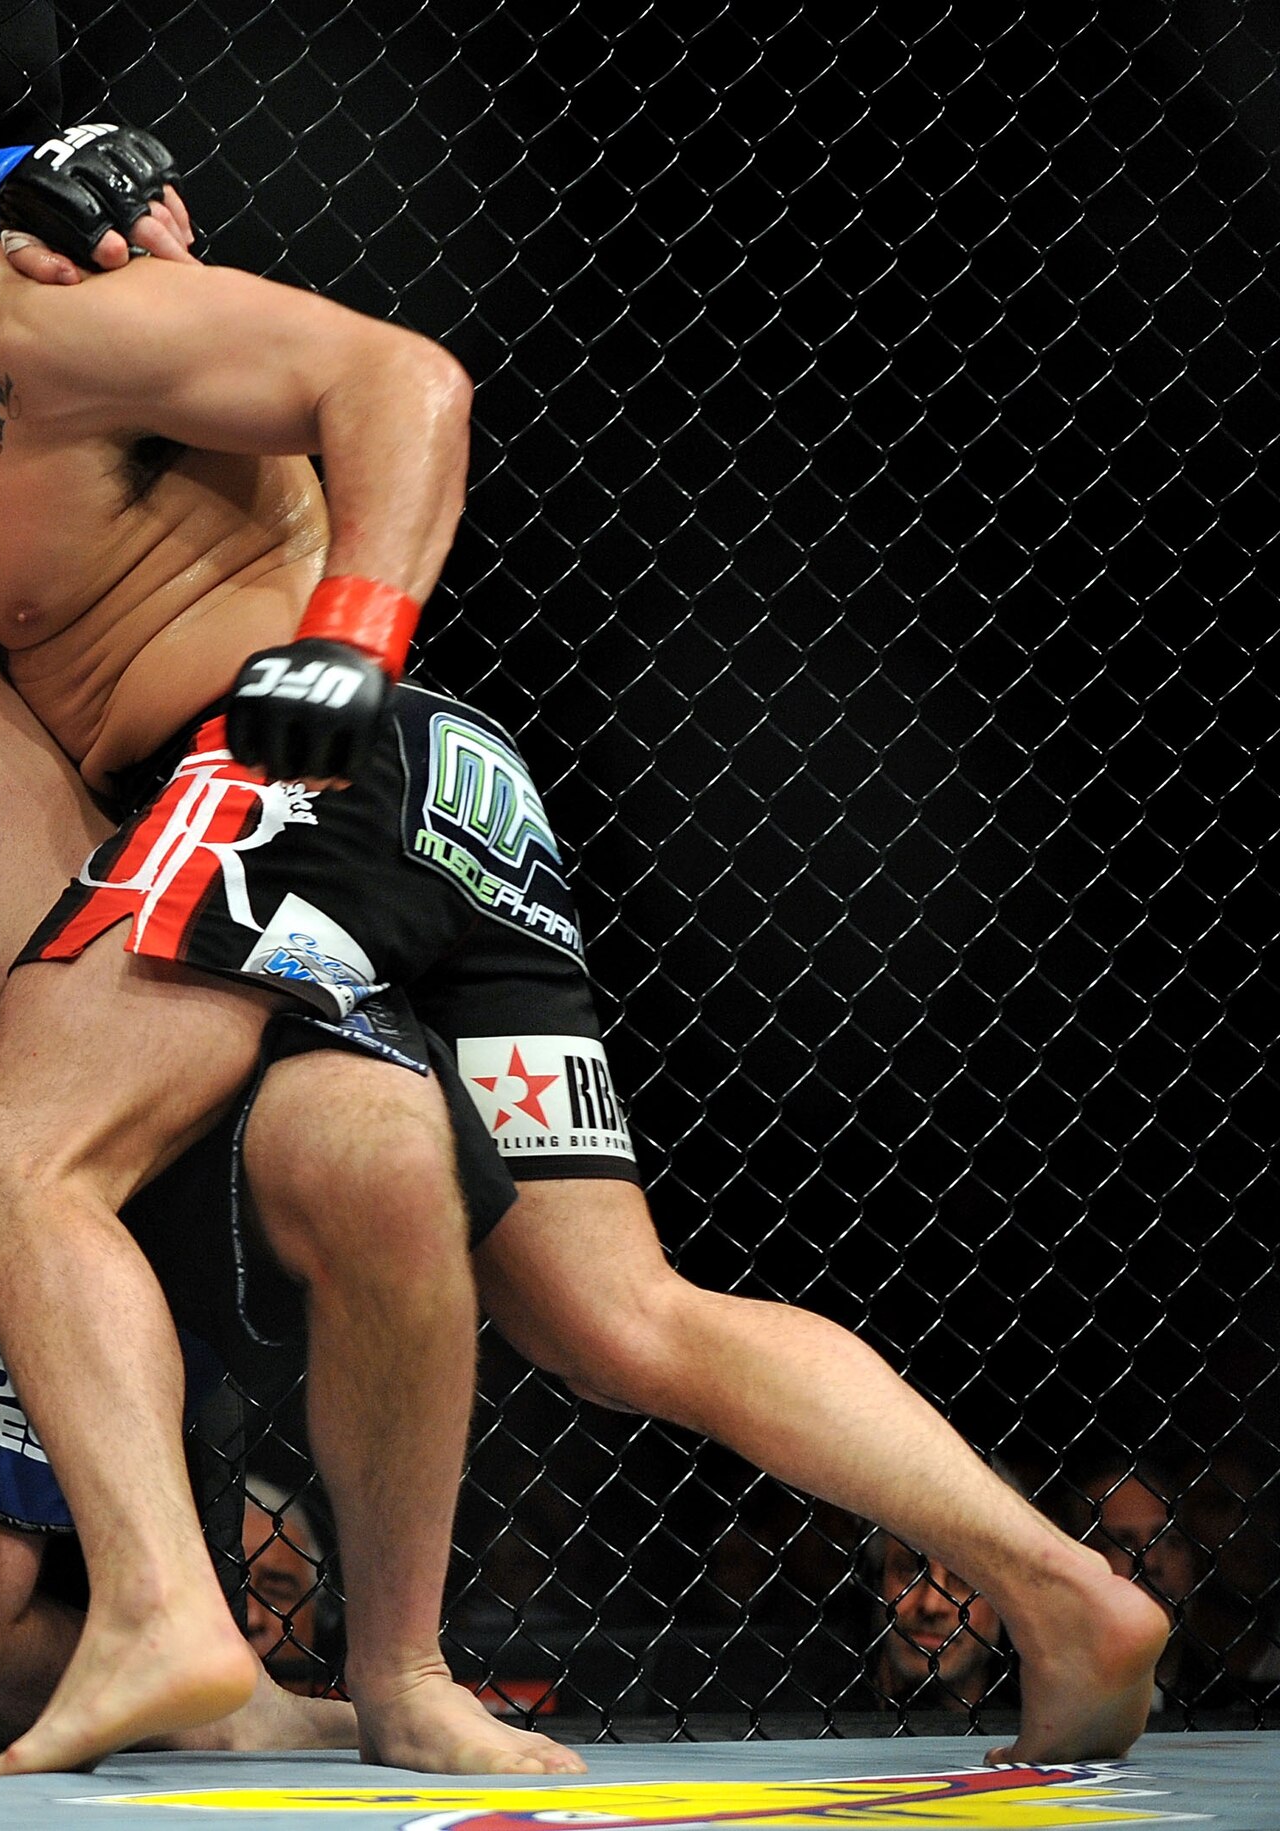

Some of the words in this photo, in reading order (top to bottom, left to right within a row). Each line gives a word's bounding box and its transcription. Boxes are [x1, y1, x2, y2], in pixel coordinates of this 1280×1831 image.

[33, 123, 120, 172] UFC
[237, 657, 366, 709] UFC
[414, 828, 584, 955] MUSCLEPHARM
[563, 1054, 626, 1135] RB
[570, 1135, 599, 1148] BIG
